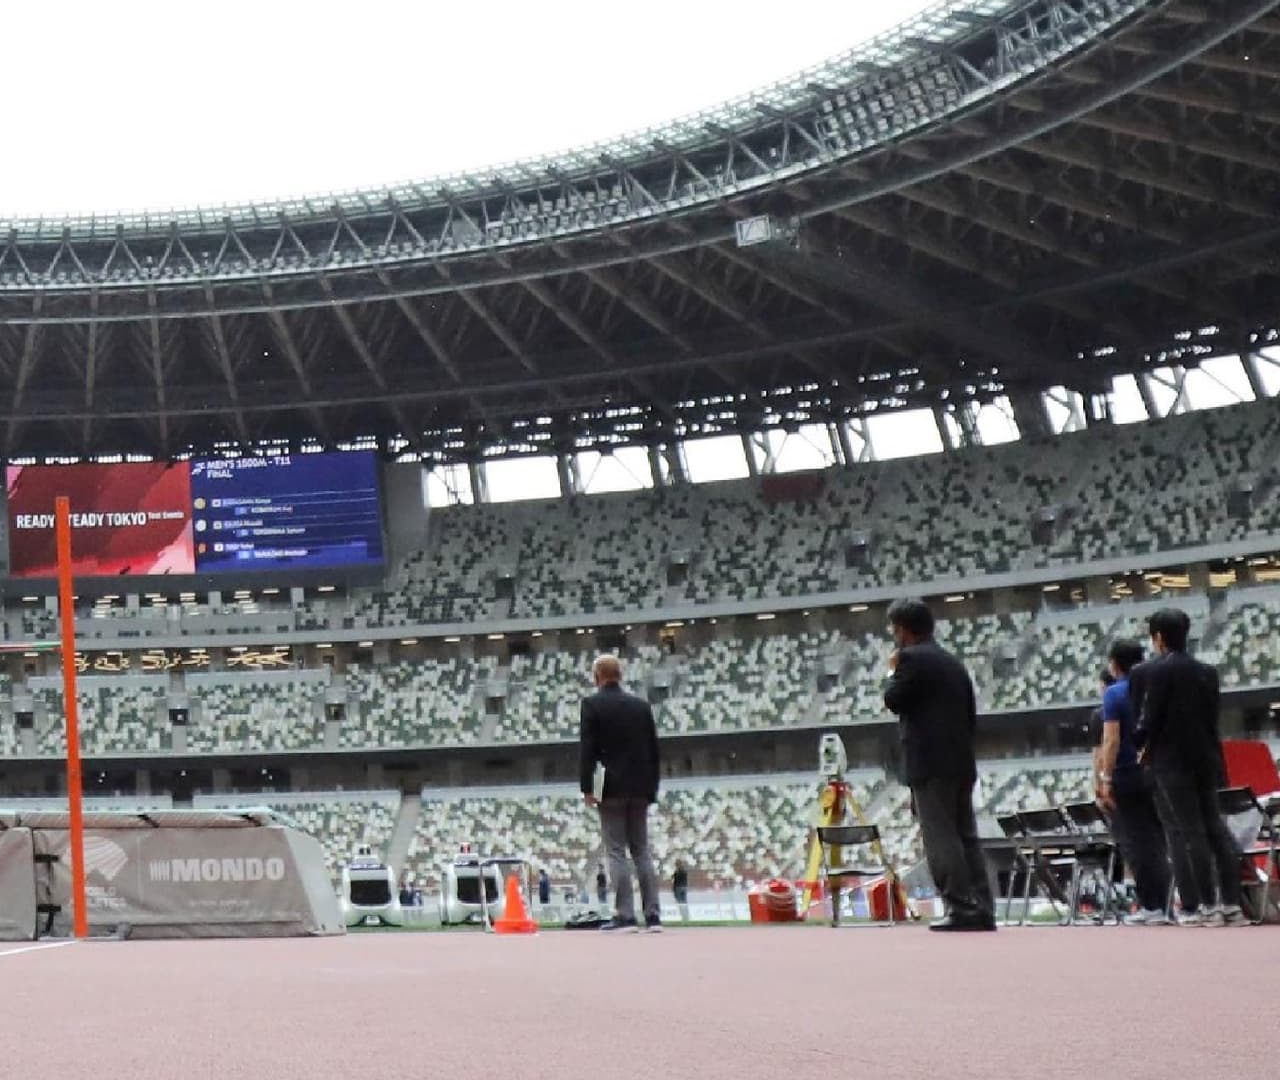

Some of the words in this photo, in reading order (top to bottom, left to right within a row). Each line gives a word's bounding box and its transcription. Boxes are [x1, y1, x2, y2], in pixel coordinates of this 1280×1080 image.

[207, 470, 233, 478] FINAL
[16, 514, 56, 528] READY
[68, 513, 104, 527] TEADY
[107, 512, 146, 525] TOKYO
[172, 858, 285, 882] MONDO
